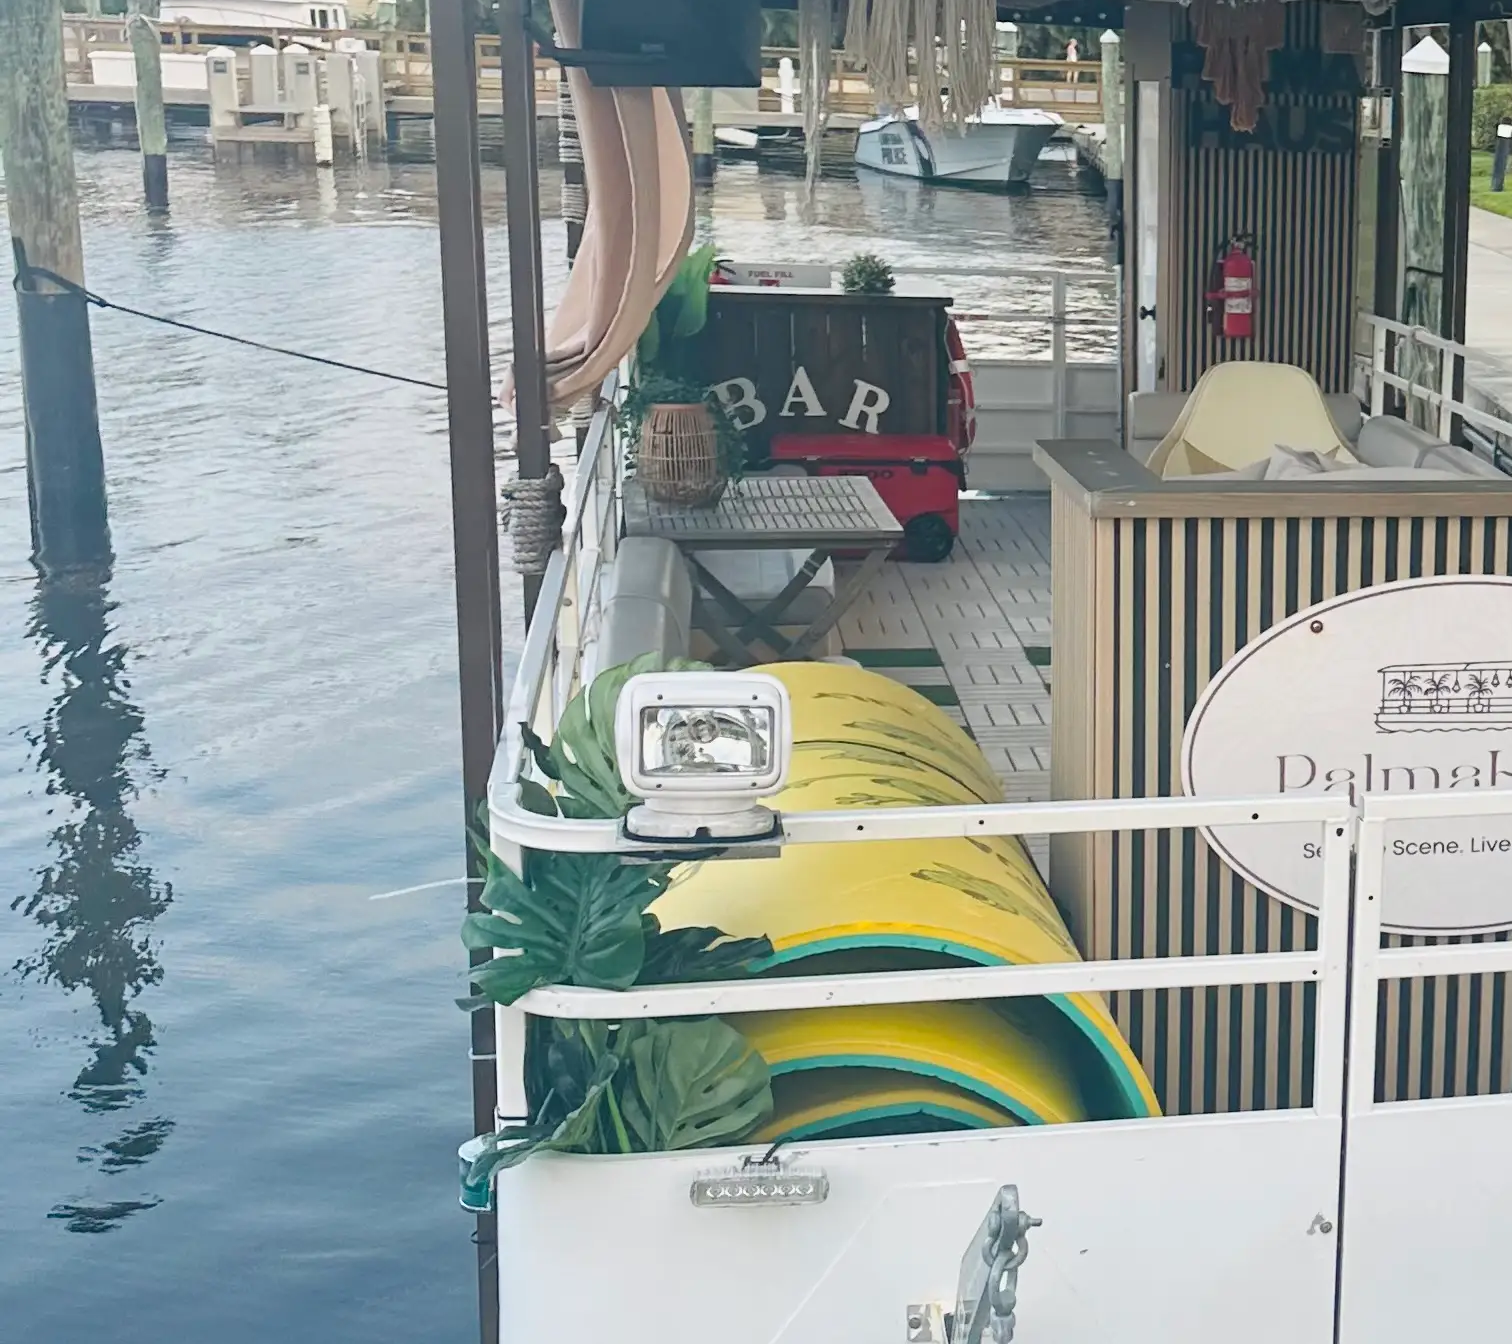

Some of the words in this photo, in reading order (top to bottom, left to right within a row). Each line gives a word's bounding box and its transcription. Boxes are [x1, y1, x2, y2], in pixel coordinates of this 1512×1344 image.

[748, 270, 772, 278] FUEL
[774, 270, 794, 278] FILL
[702, 365, 890, 435] BAR
[1392, 839, 1464, 856] Scene.
[1470, 836, 1512, 853] Live
